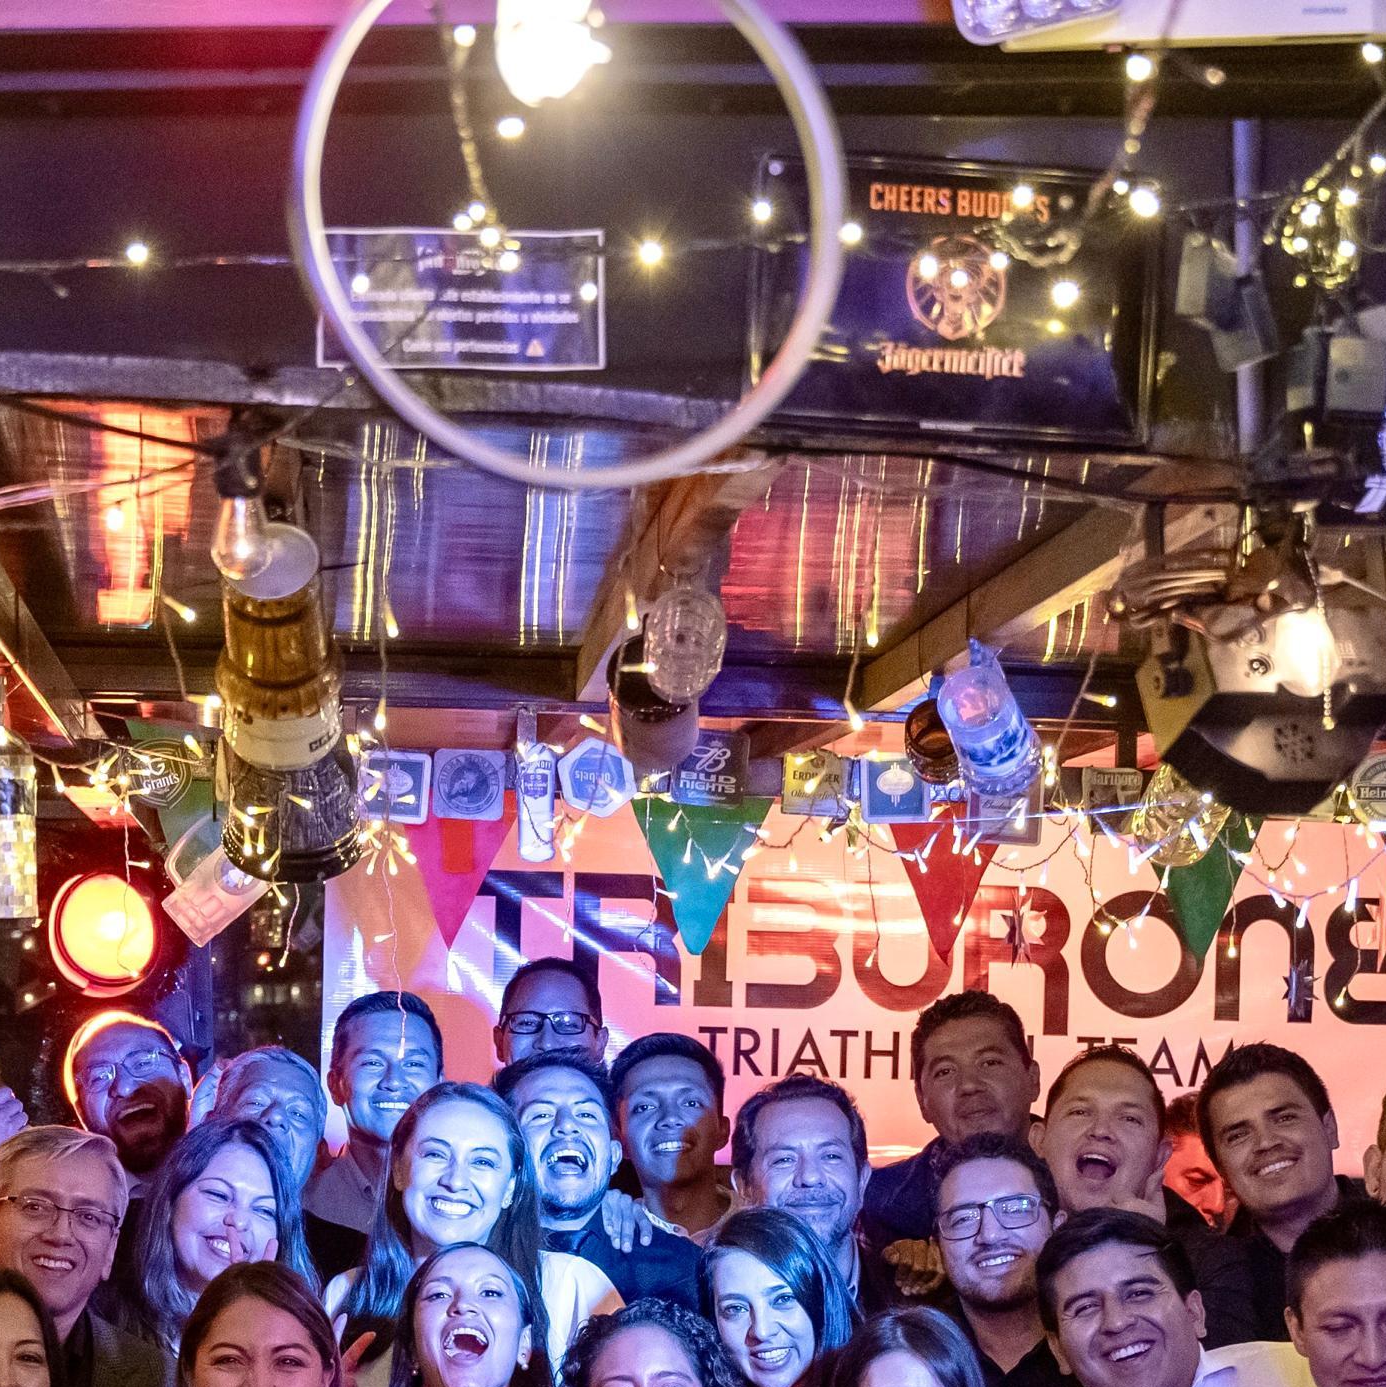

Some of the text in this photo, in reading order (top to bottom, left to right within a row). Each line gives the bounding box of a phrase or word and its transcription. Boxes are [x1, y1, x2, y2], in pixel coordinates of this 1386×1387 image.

[869, 181, 1050, 224] CHEERS BUDDS
[680, 771, 737, 785] BUD
